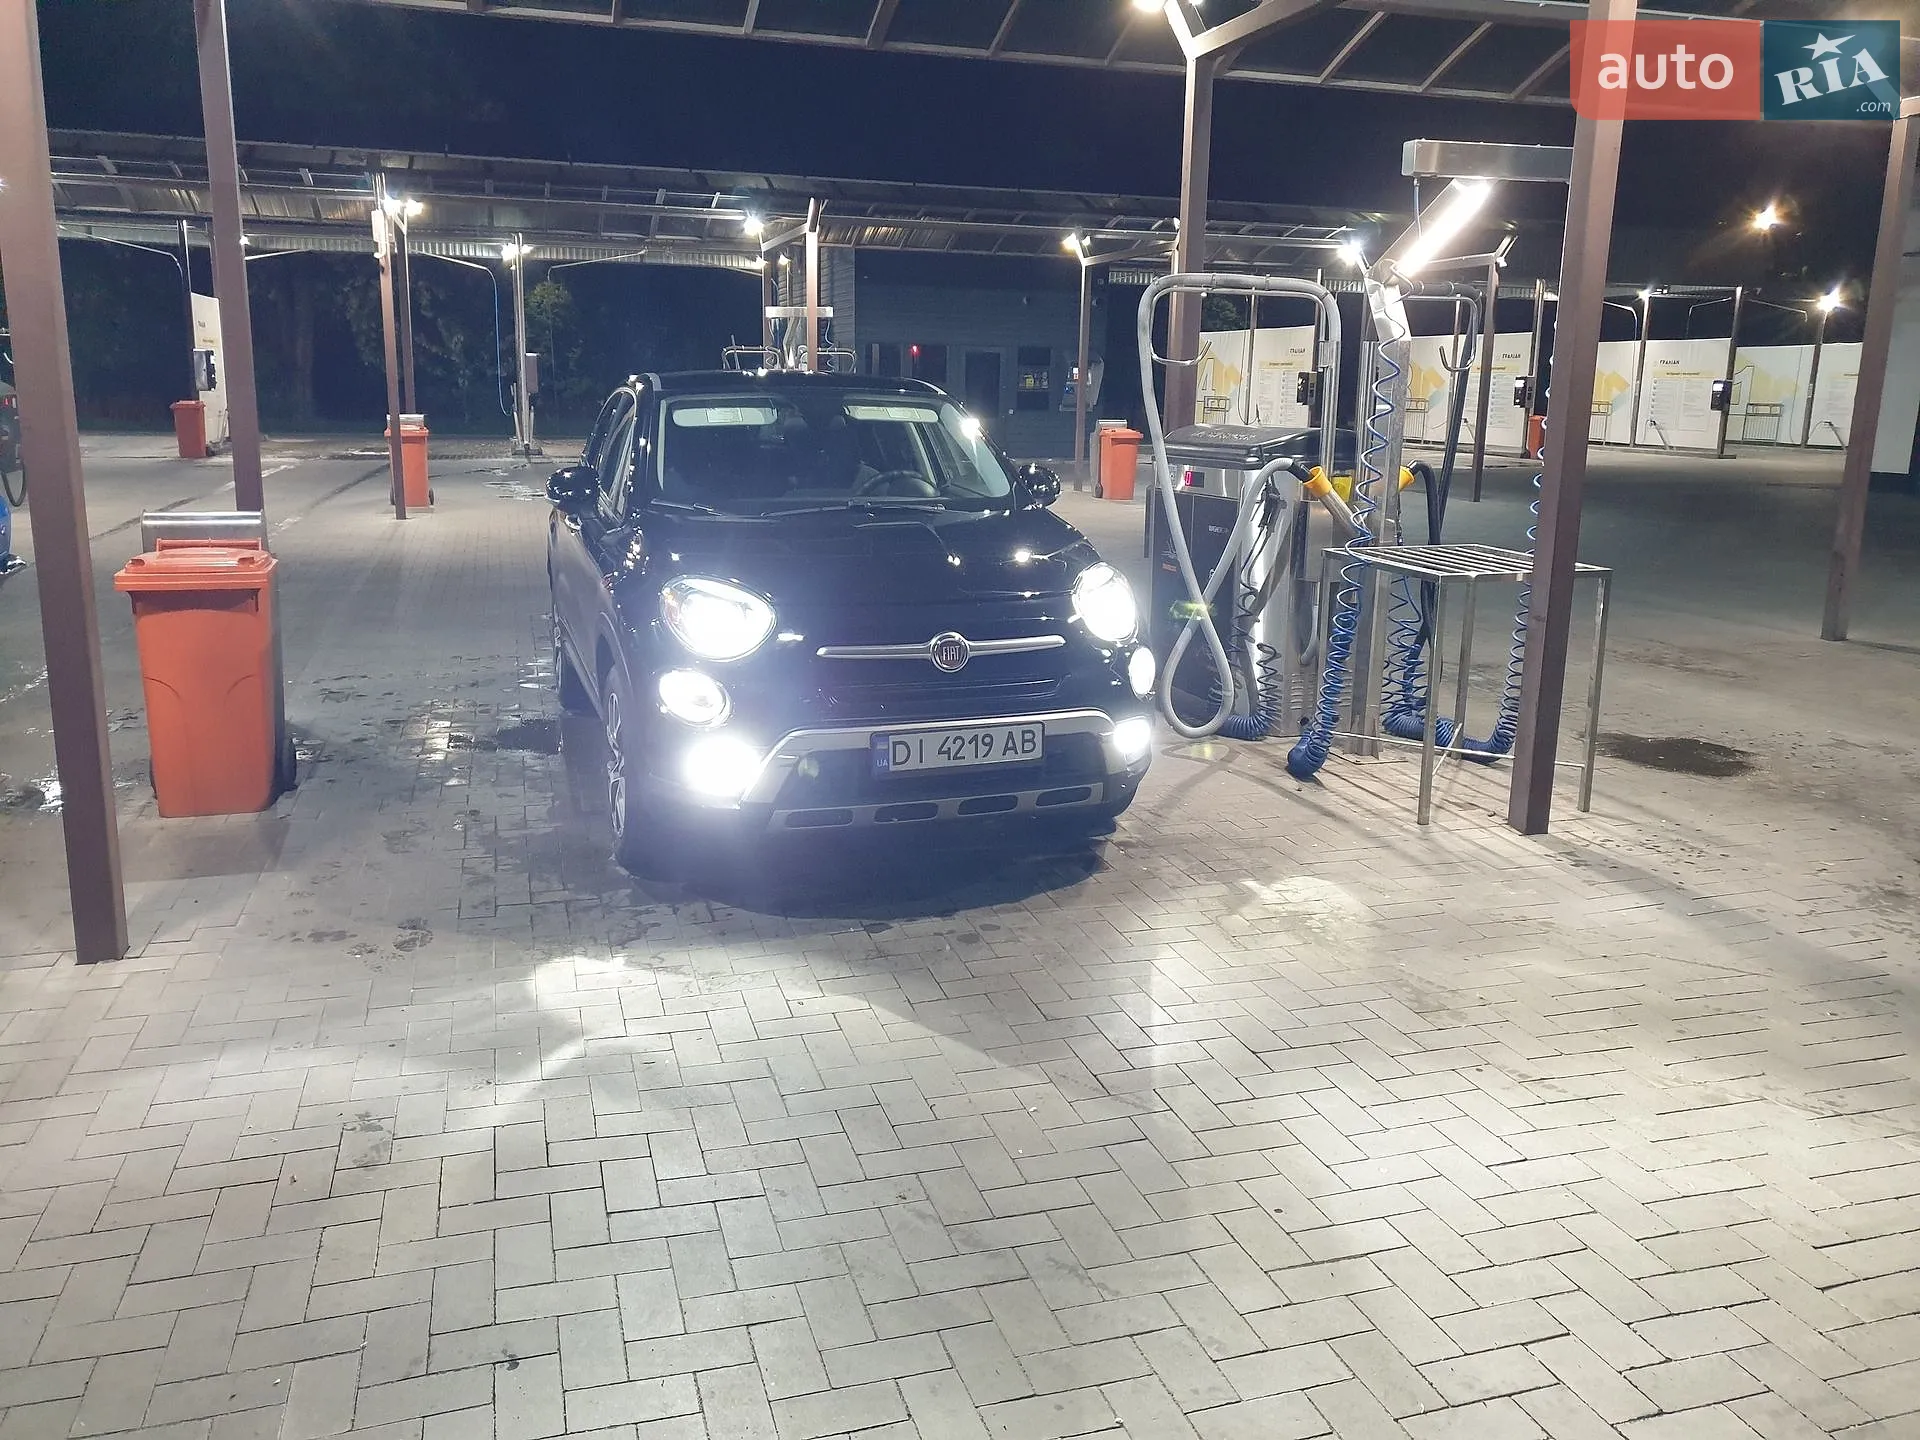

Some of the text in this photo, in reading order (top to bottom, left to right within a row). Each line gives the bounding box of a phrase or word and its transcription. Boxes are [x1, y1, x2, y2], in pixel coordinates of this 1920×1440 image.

[942, 645, 960, 661] FIAT
[892, 729, 1037, 766] DI 4219 AB
[876, 759, 889, 768] UA
